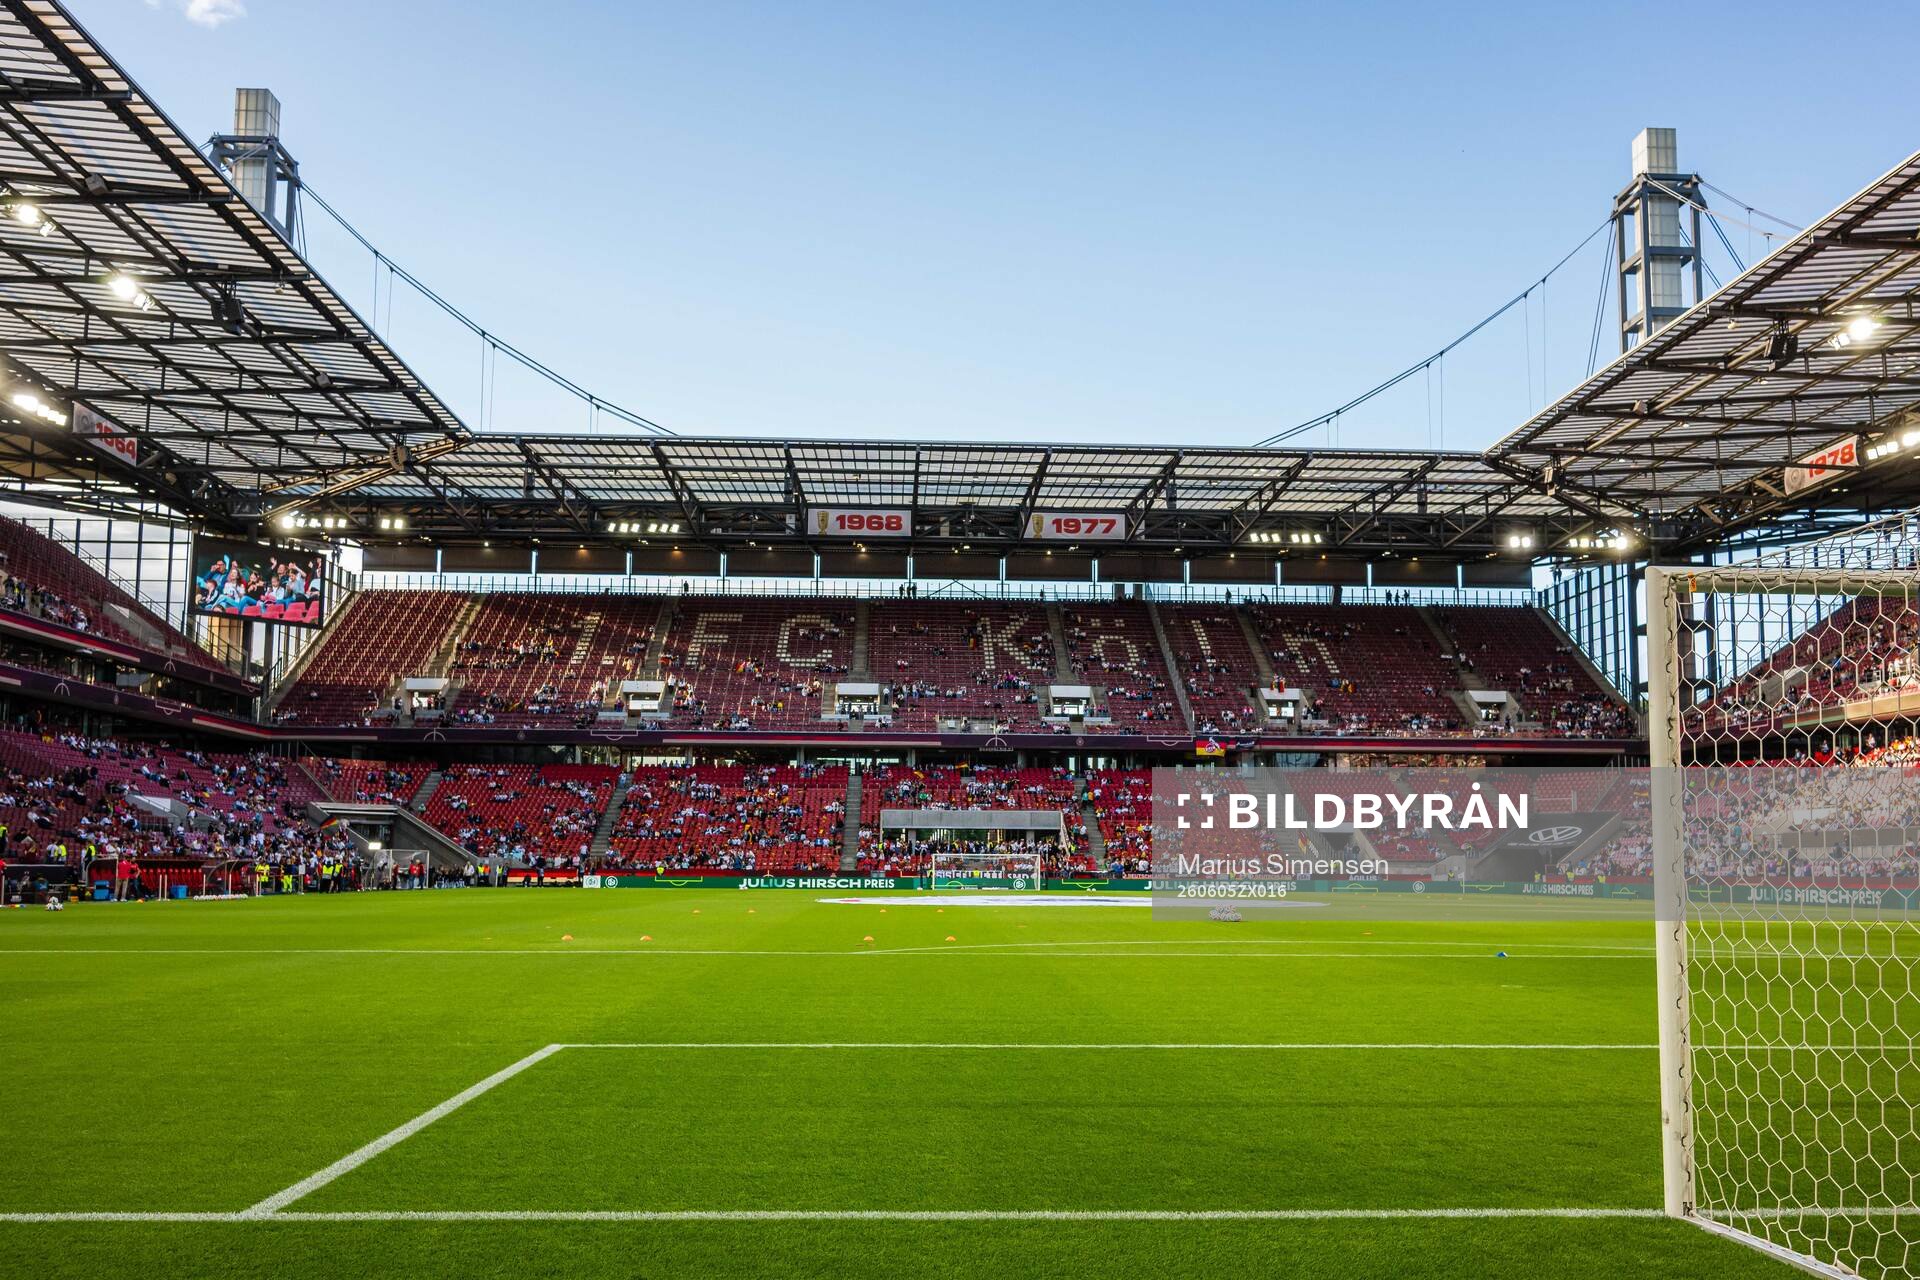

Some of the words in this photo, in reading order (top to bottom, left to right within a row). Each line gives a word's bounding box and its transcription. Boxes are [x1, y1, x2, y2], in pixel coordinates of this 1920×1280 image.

[1808, 443, 1855, 478] 1978
[835, 514, 903, 531] 1968
[1052, 518, 1117, 534] 1977
[739, 879, 795, 889] JULIUS
[799, 879, 861, 888] HIRSCH
[864, 879, 895, 889] PREIS
[1522, 884, 1547, 894] JULIUS
[1548, 884, 1577, 895] HIRSCH
[1578, 884, 1594, 896] PREIS
[1748, 888, 1792, 902] JULIUS
[1795, 889, 1849, 904] HIRSCH
[1852, 890, 1882, 905] PREIS
